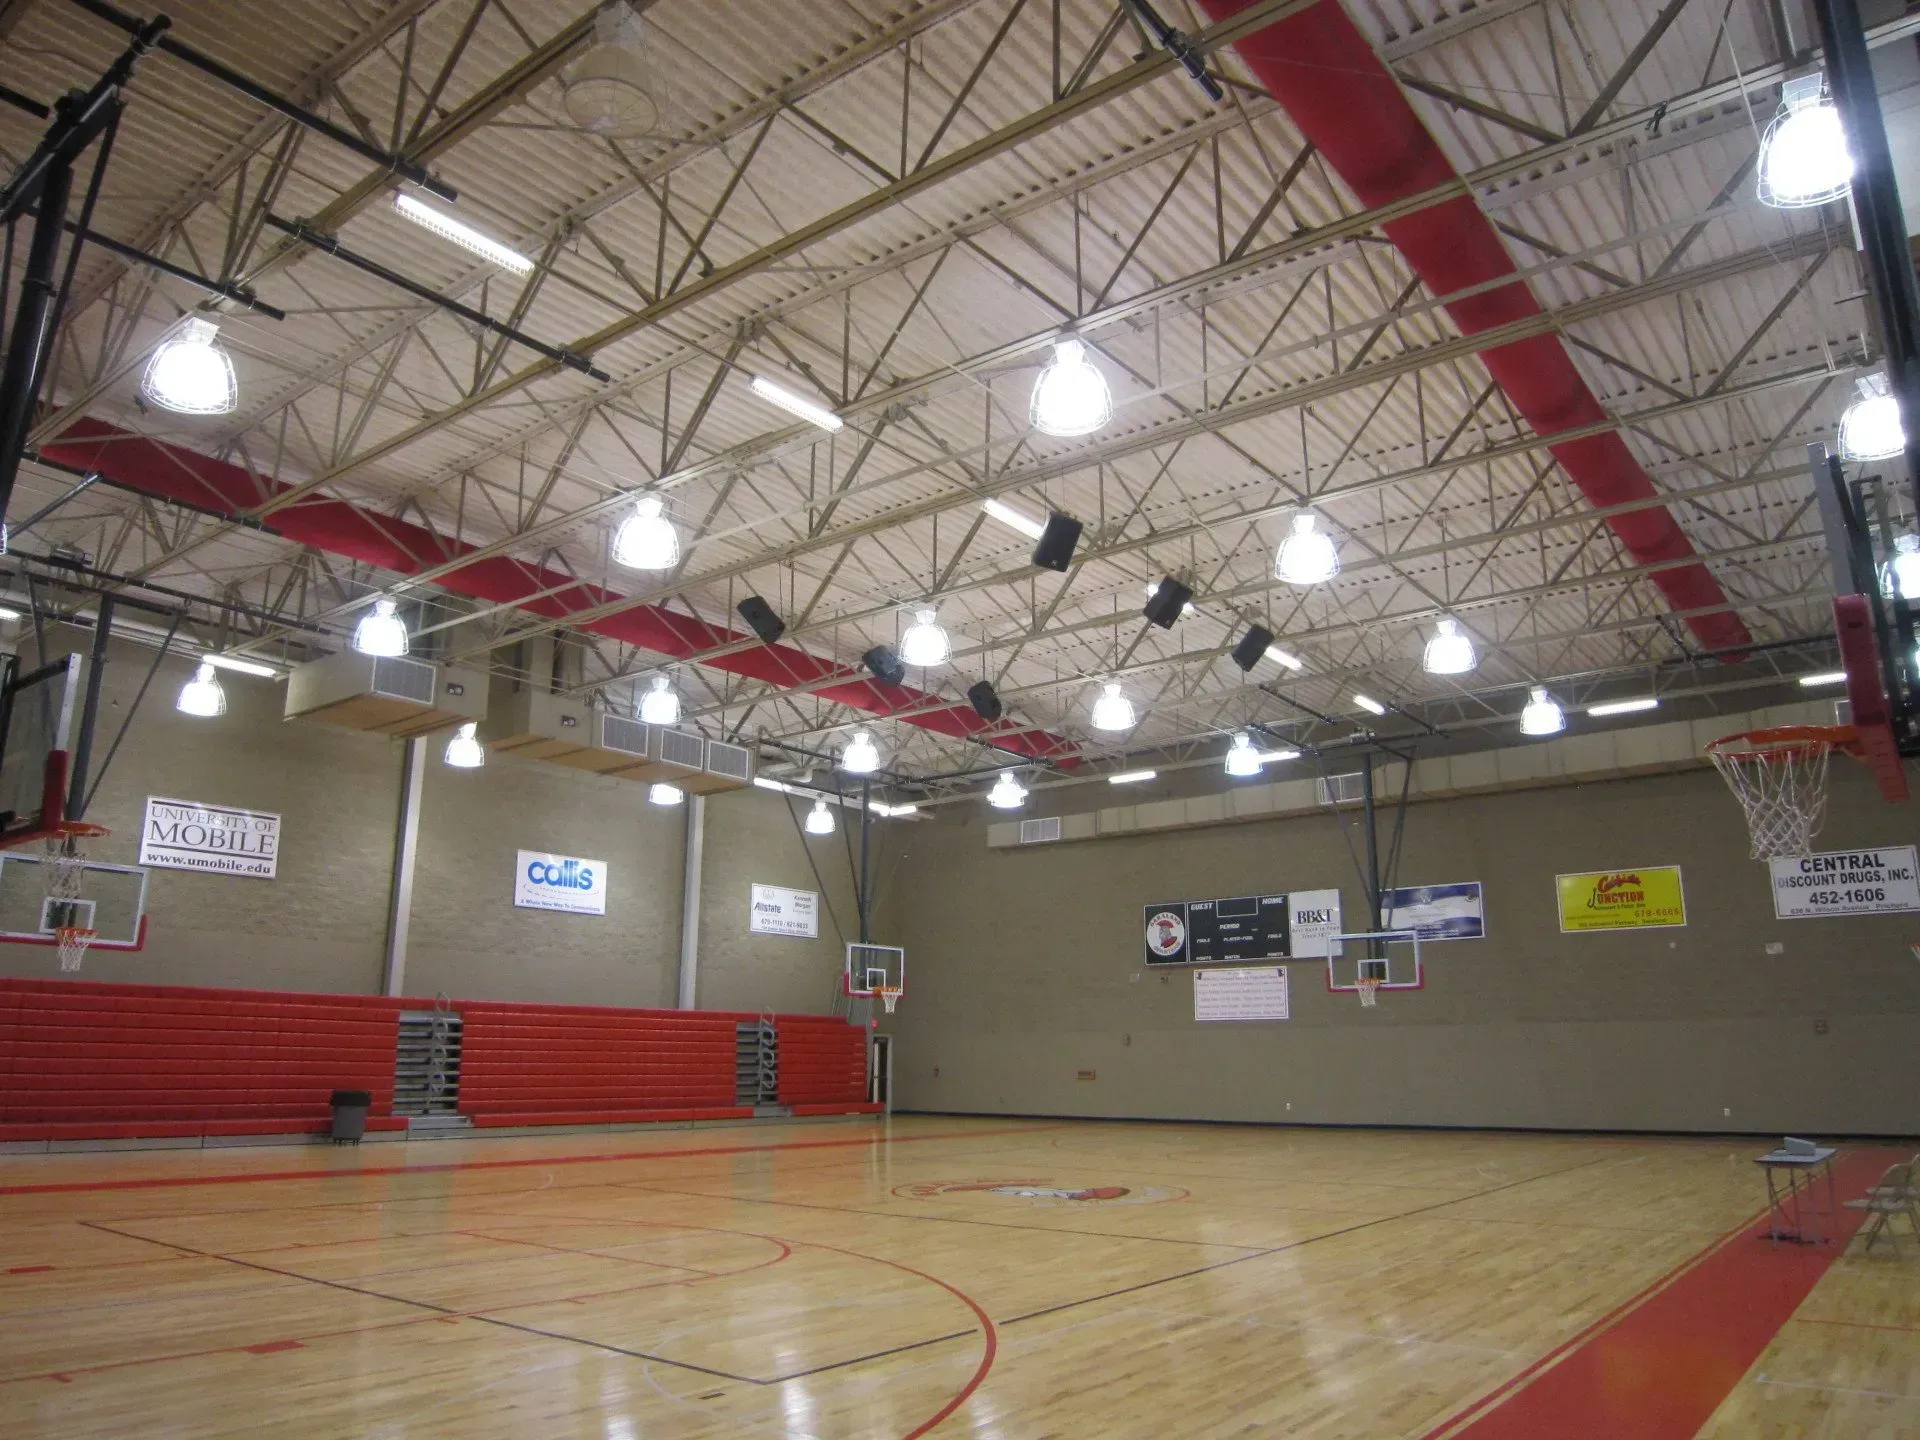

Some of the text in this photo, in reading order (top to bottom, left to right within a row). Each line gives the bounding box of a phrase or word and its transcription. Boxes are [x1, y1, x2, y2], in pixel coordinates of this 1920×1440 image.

[152, 806, 276, 832] UNIVERSITY OF
[149, 820, 275, 855] MOBILE
[147, 853, 271, 874] www.umobile.edu
[1800, 853, 1885, 873] CENTRAL
[1778, 868, 1914, 888] DISCOUNT DRUGS, INC.
[1262, 896, 1283, 905] HOME
[1809, 888, 1885, 905] 452-1606
[754, 902, 781, 913] Allstate
[1190, 902, 1213, 911] GUEST
[1297, 909, 1333, 924] BB&T
